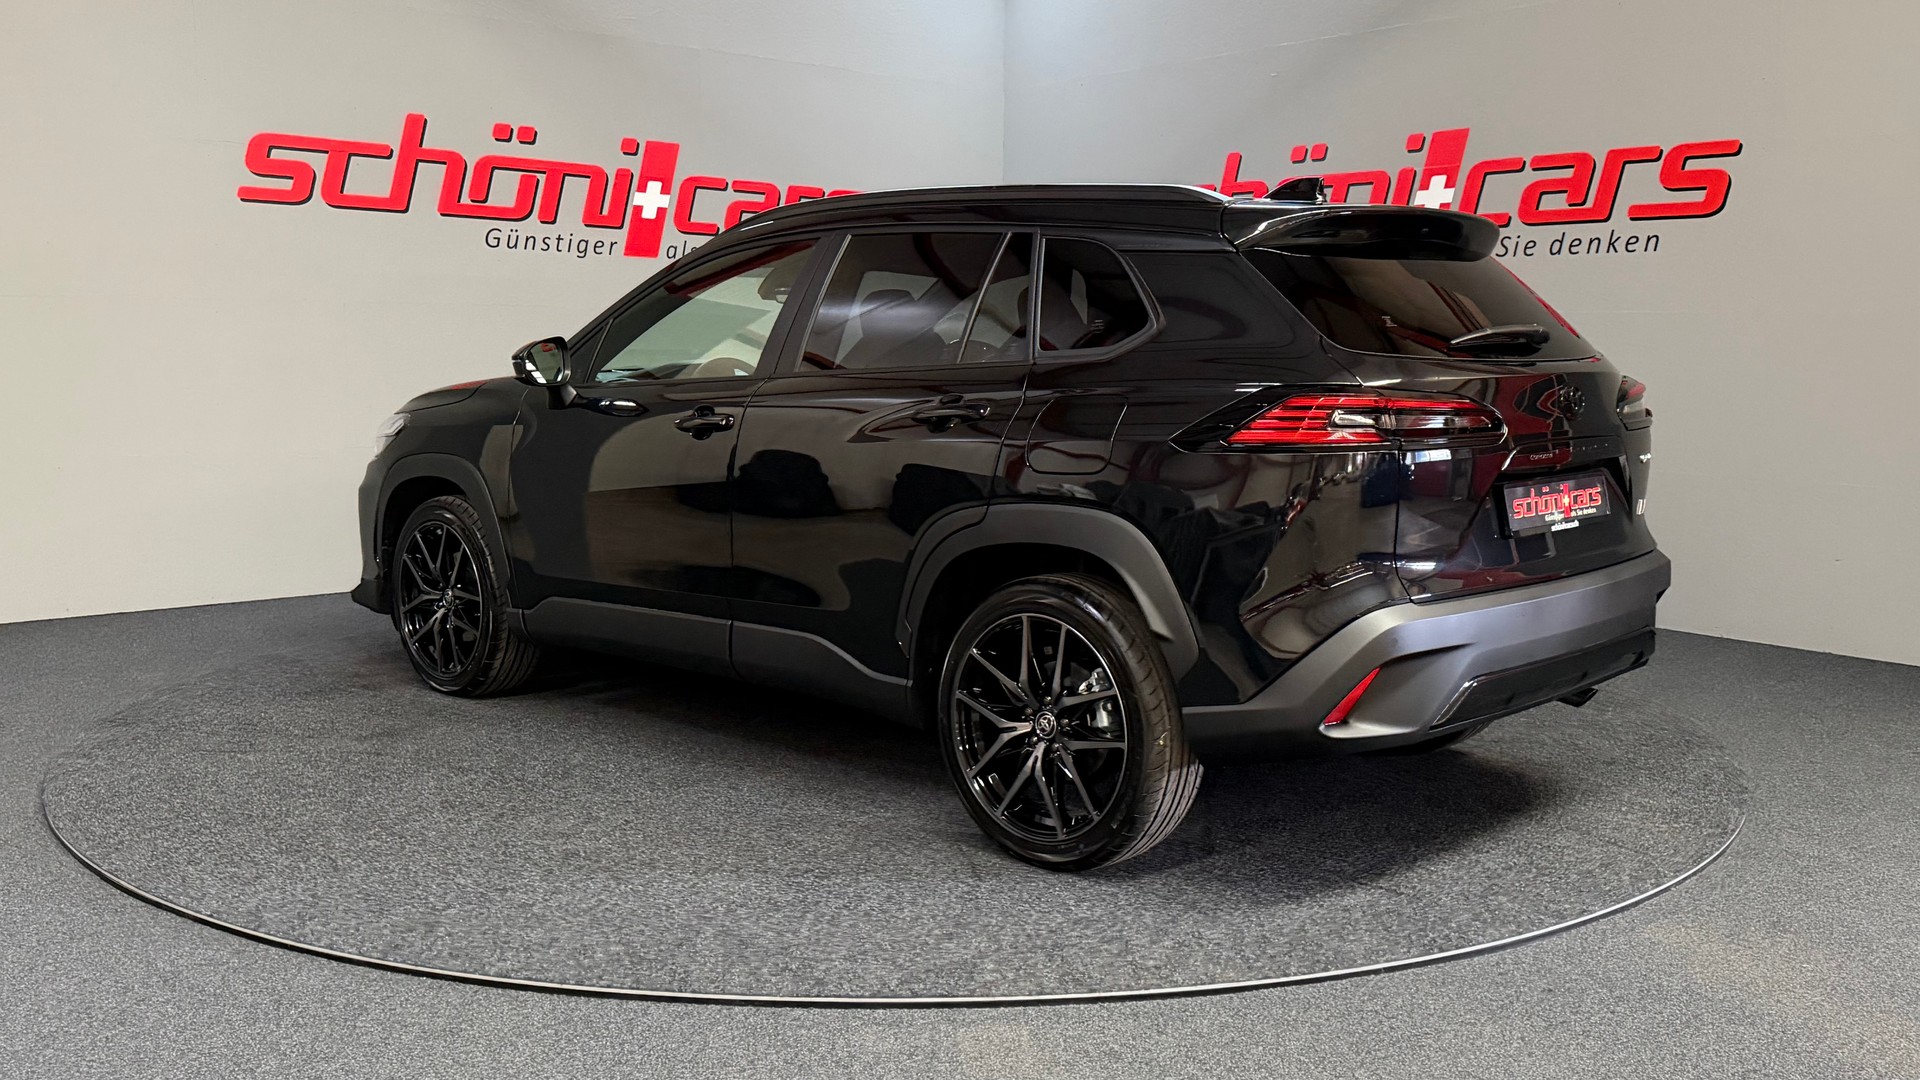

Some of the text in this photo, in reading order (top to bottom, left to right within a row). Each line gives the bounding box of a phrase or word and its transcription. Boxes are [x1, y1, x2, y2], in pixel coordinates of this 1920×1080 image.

[237, 112, 866, 235] schöni car
[1457, 139, 1742, 227] cars
[485, 227, 618, 259] Günstiger
[1495, 229, 1661, 258] Sie denken
[1570, 487, 1601, 509] cars
